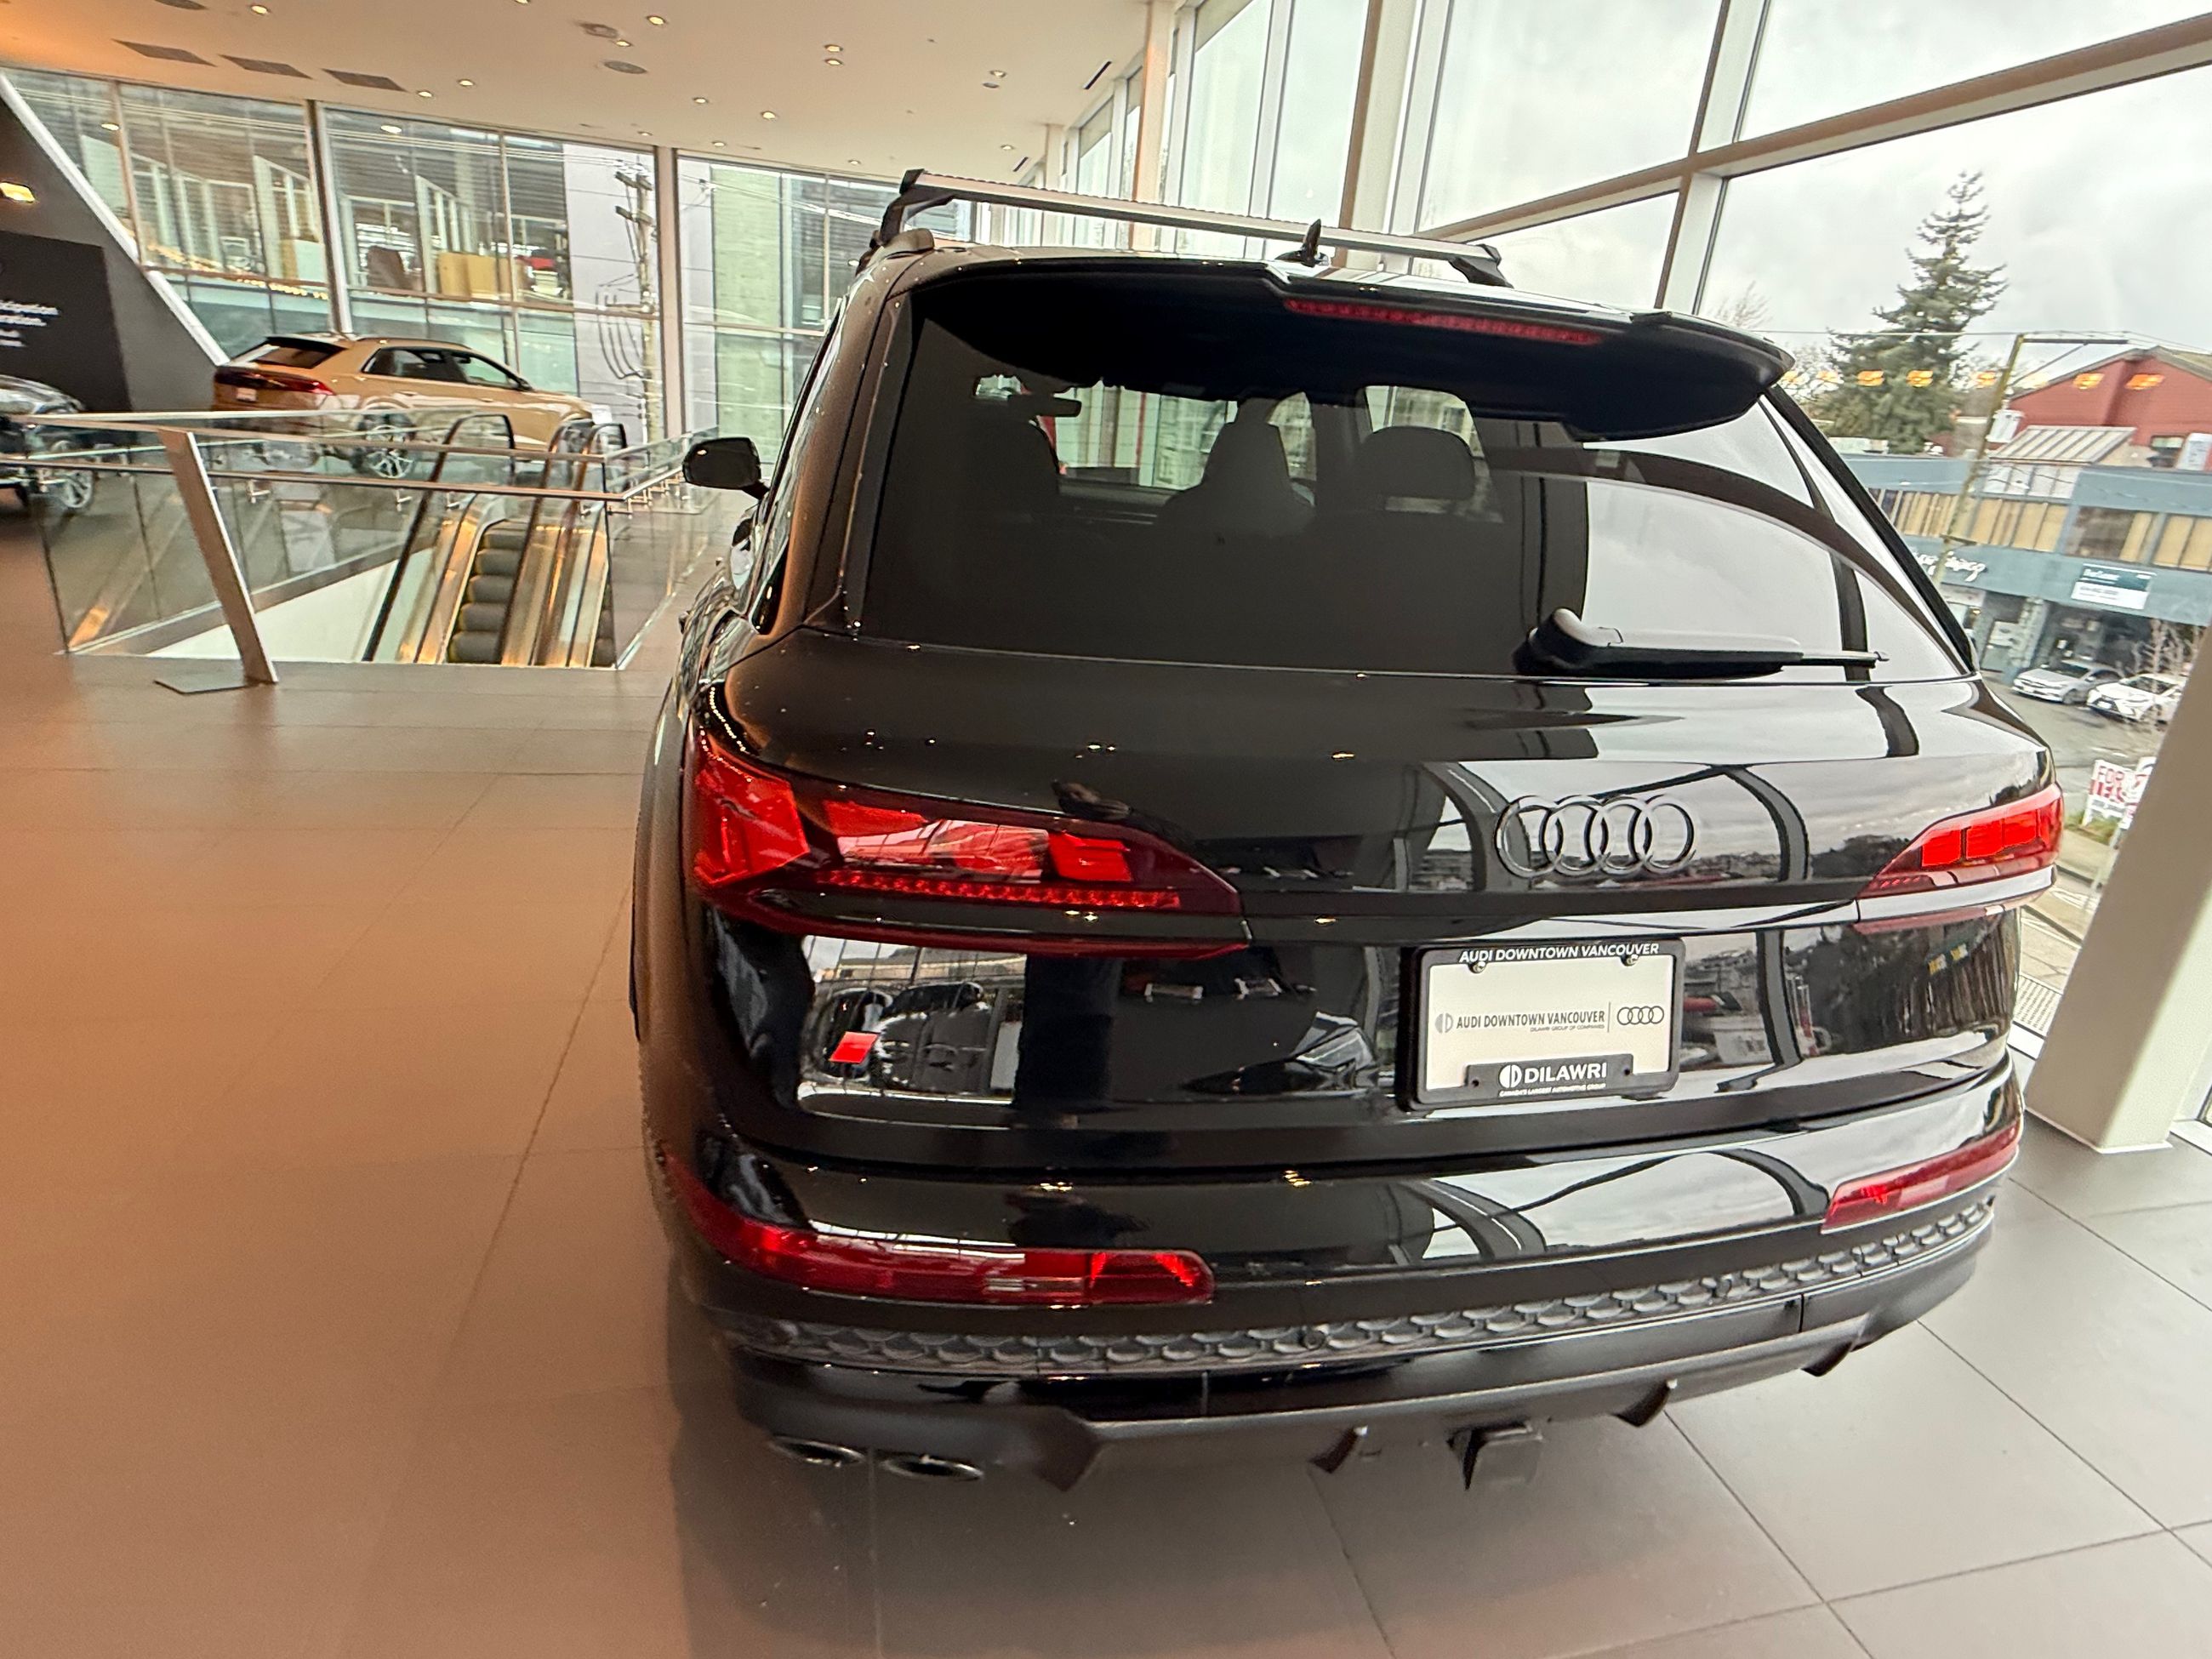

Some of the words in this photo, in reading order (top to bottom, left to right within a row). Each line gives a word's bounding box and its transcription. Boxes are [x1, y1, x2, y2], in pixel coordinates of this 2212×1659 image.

[2097, 765, 2125, 789] FOR
[1458, 949, 1493, 962] AUDI
[1495, 946, 1579, 961] DOWNTOWN
[1581, 943, 1660, 957] VANCOUVER
[1456, 1015, 1481, 1029] AUDI
[1483, 1013, 1545, 1028] DOWNTOWN
[1547, 1011, 1605, 1024] VANCOUVER
[1524, 1062, 1607, 1084] DILAWRI
